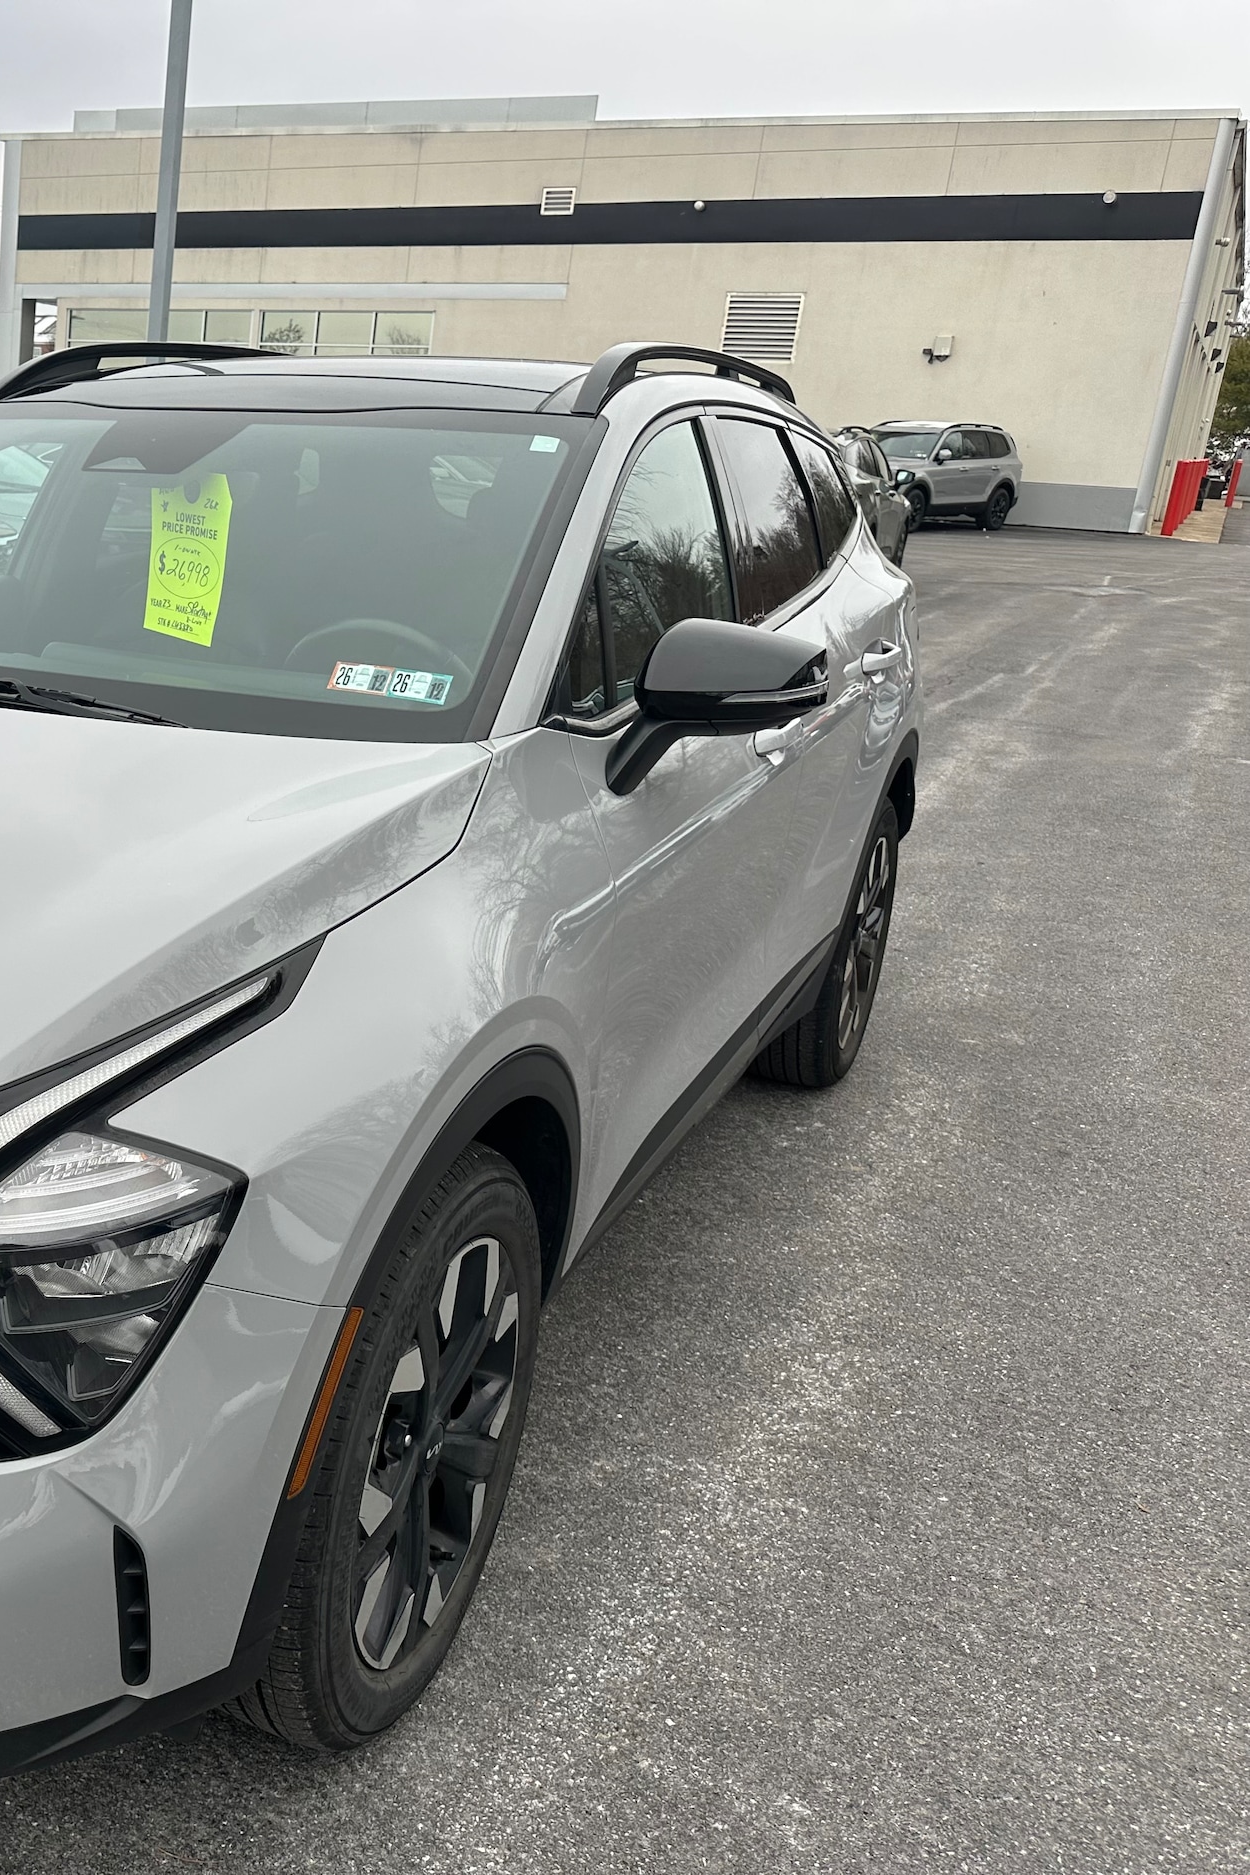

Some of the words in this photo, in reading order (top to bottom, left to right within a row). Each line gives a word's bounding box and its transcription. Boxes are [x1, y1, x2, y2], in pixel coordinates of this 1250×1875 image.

[175, 511, 206, 527] LOWEST
[161, 521, 184, 535] PRICE
[185, 525, 218, 541] PROMISE
[335, 666, 354, 686] 26
[371, 674, 388, 691] 12
[391, 673, 411, 693] 26
[428, 681, 445, 701] 12
